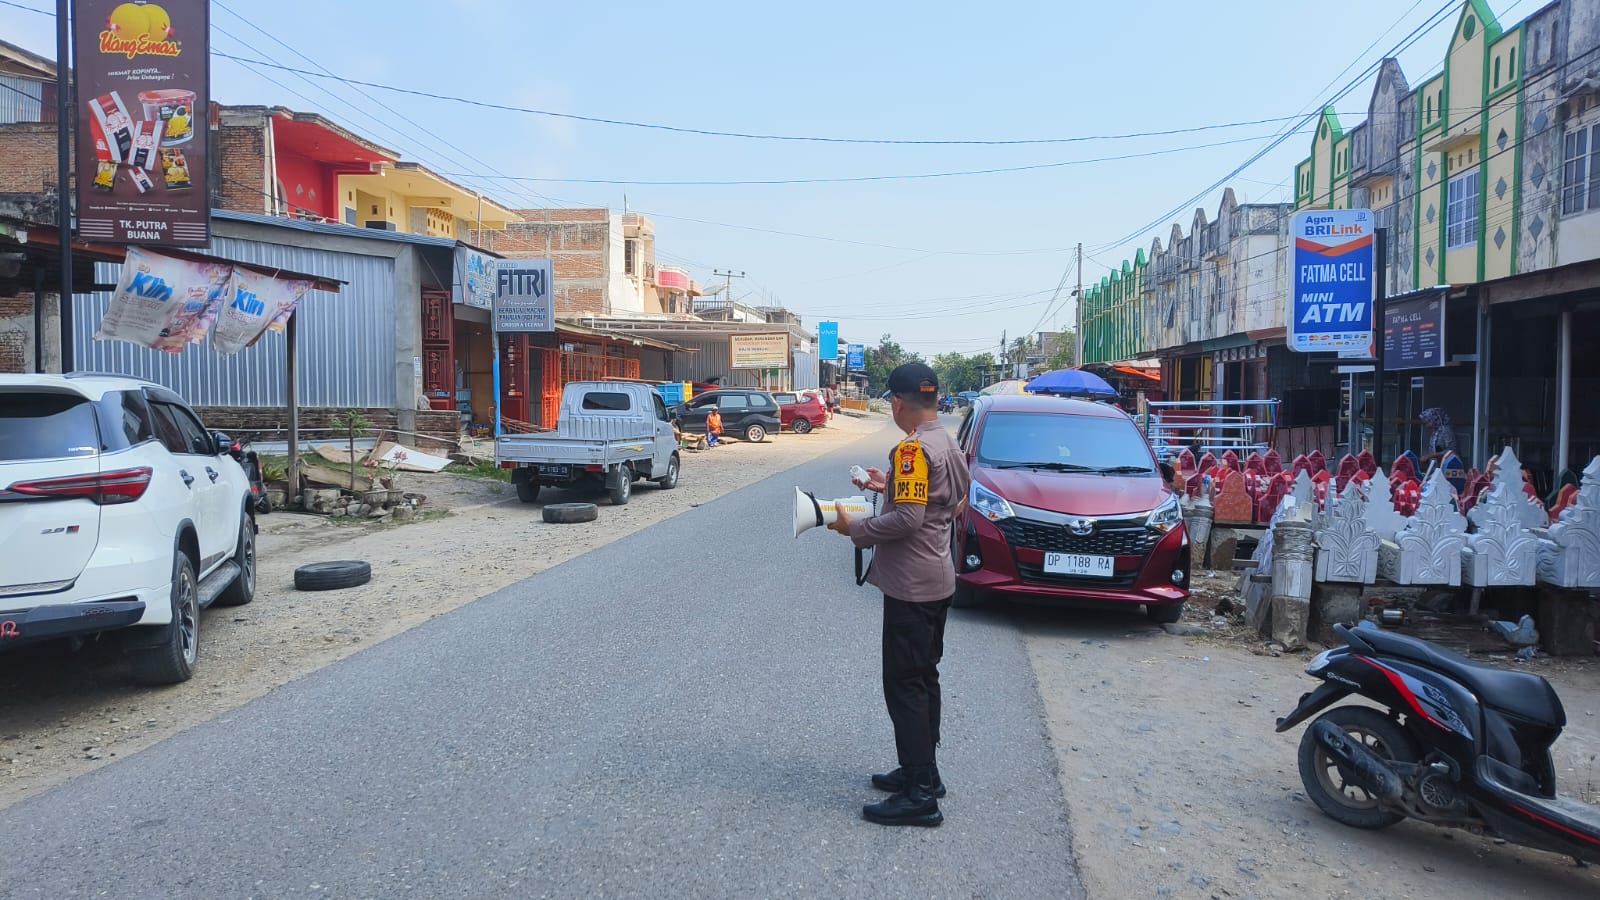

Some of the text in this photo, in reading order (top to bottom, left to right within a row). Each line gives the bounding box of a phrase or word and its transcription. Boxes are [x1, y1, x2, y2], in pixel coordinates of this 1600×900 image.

[119, 220, 168, 230] TK. PUTRA
[1305, 216, 1334, 225] Agen
[127, 231, 160, 240] BUANA
[1304, 224, 1363, 236] BRILink
[1301, 262, 1366, 284] FATMA CELL
[126, 271, 173, 302] Klin
[497, 269, 546, 298] FITRI
[230, 288, 265, 317] Klin
[1301, 292, 1334, 303] MINI
[1300, 302, 1366, 324] ATM
[914, 482, 926, 498] SEK
[1048, 554, 1111, 570] DP 1188 RA
